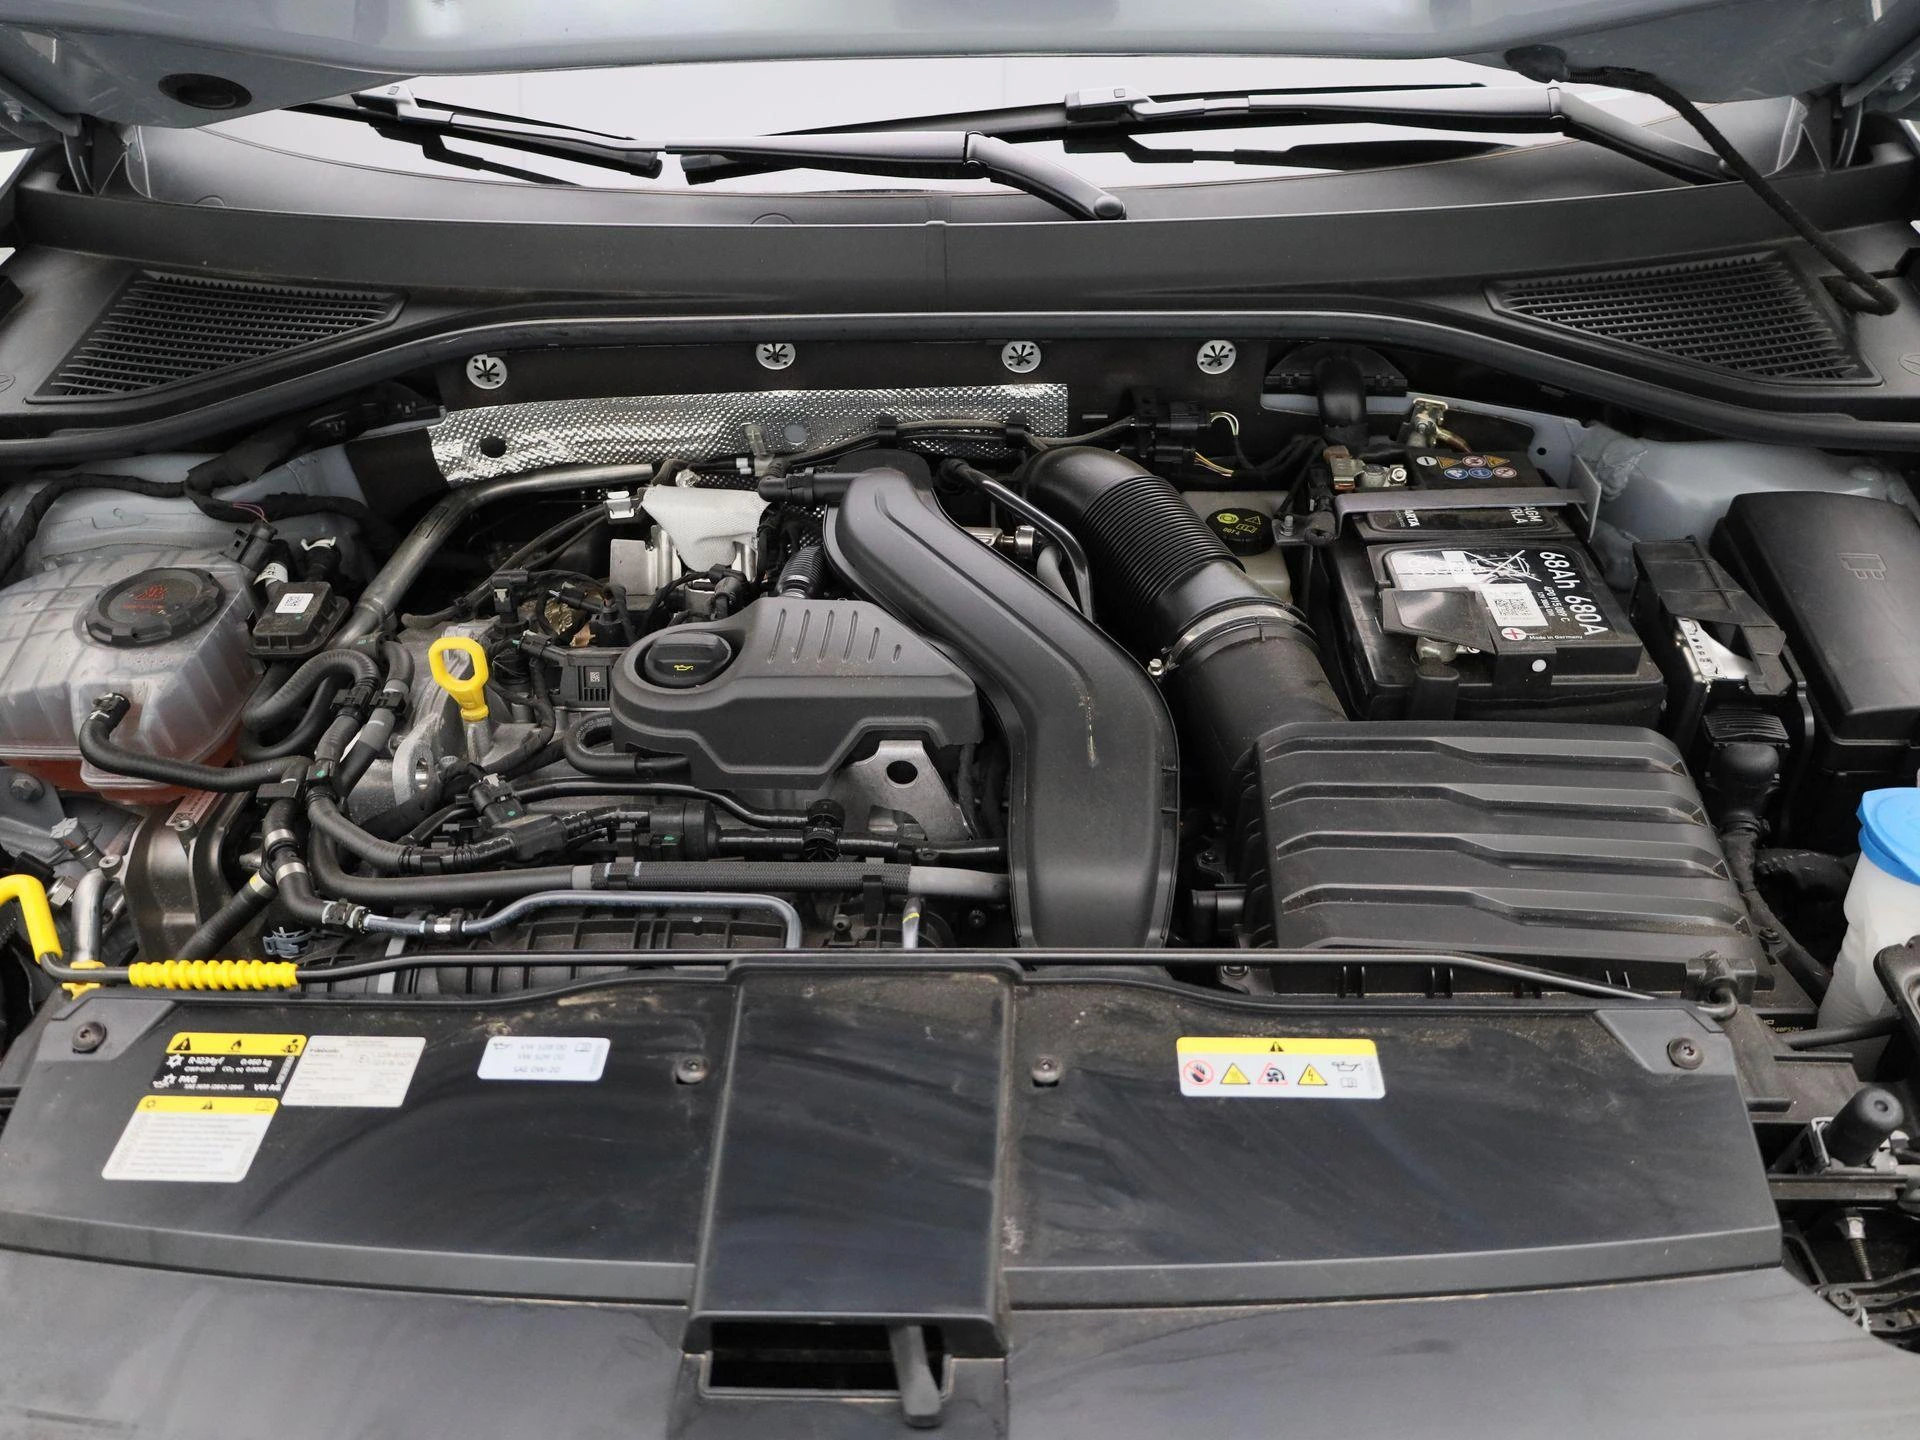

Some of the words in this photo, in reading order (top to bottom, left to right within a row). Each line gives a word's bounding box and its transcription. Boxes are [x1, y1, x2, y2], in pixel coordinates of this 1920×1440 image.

[1404, 509, 1420, 527] ARTA
[1509, 507, 1528, 524] RLA
[1539, 551, 1581, 589] 68Ah
[1564, 595, 1609, 636] 680A
